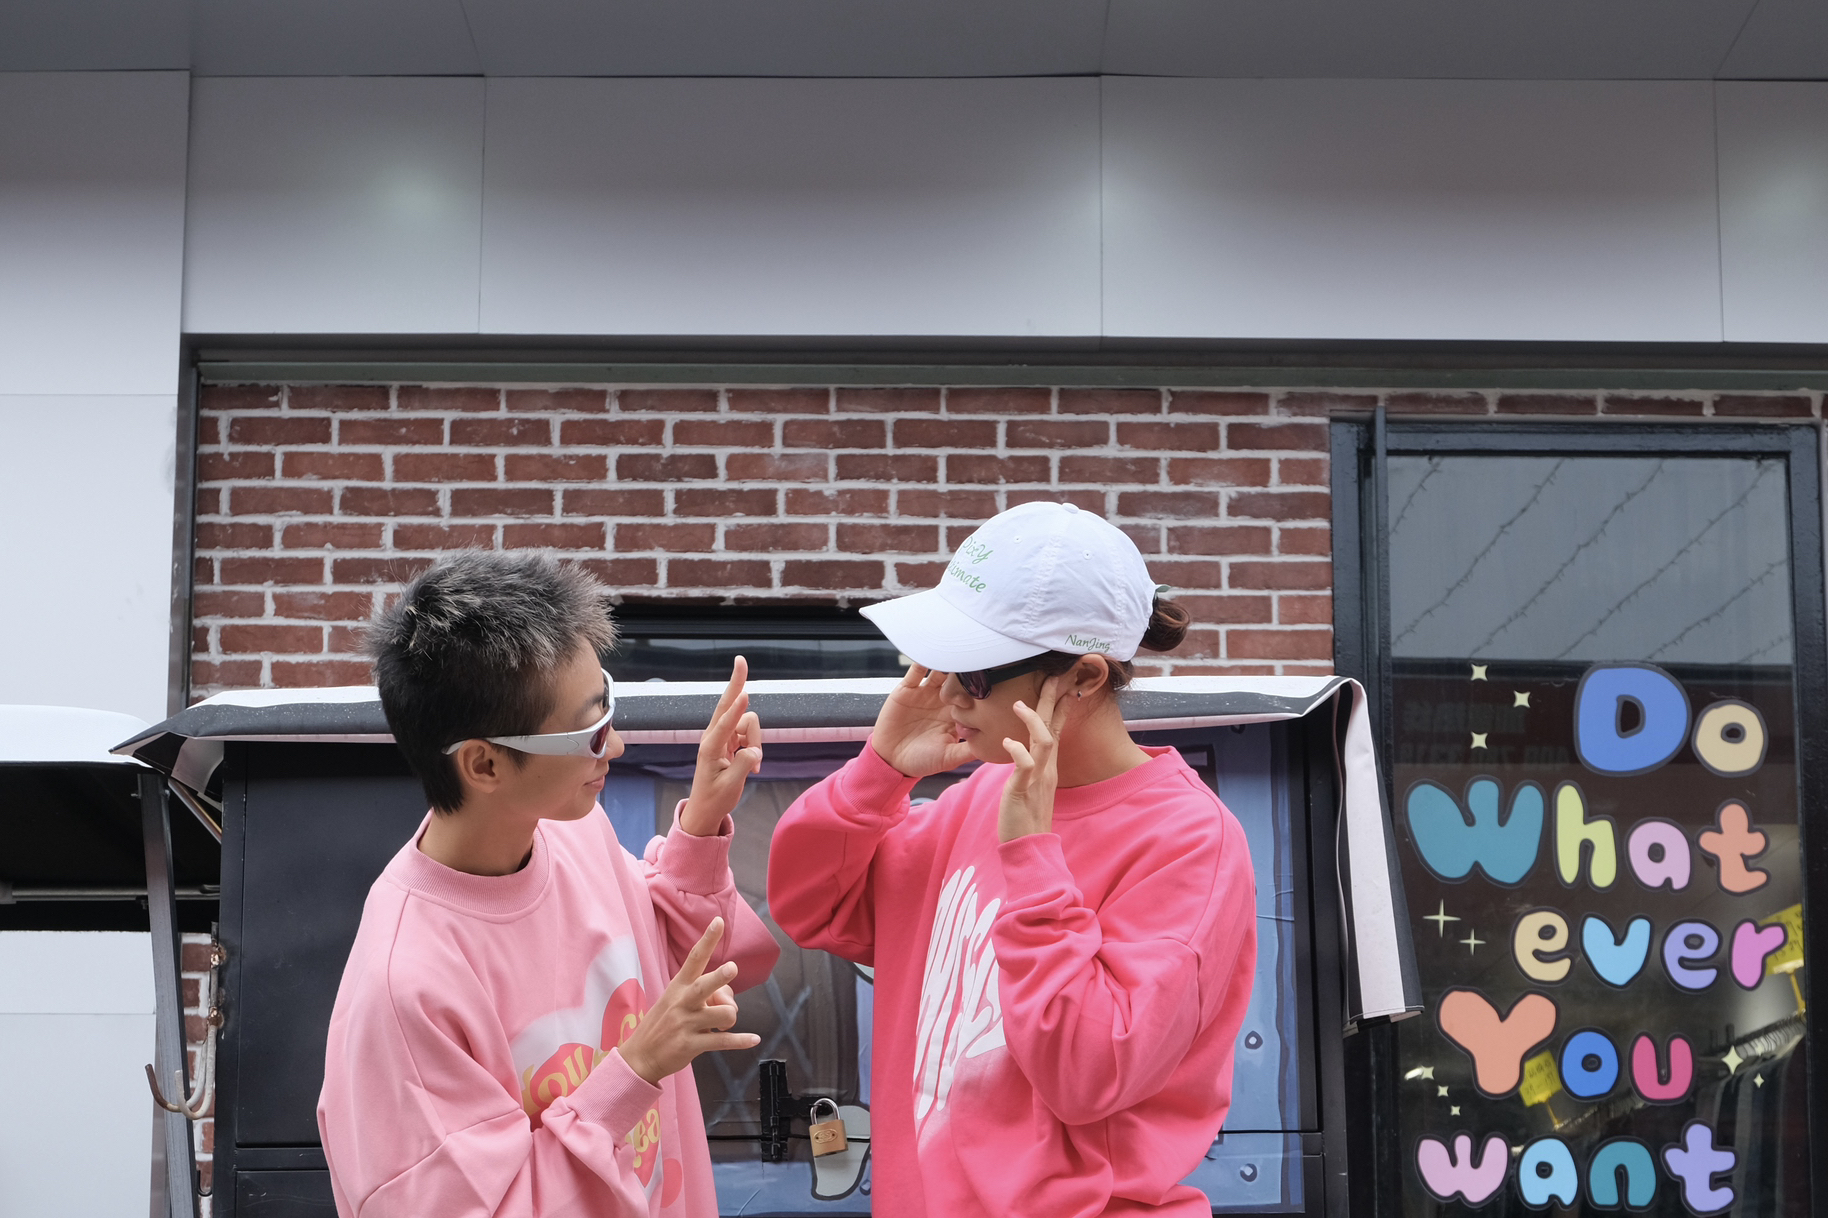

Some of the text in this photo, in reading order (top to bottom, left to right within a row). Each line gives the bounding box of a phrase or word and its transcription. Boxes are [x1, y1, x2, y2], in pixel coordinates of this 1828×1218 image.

[1575, 663, 1769, 776] Do
[1405, 776, 1769, 894] What
[1512, 908, 1788, 991] ever
[1437, 987, 1694, 1103] You
[1416, 1123, 1736, 1214] want
